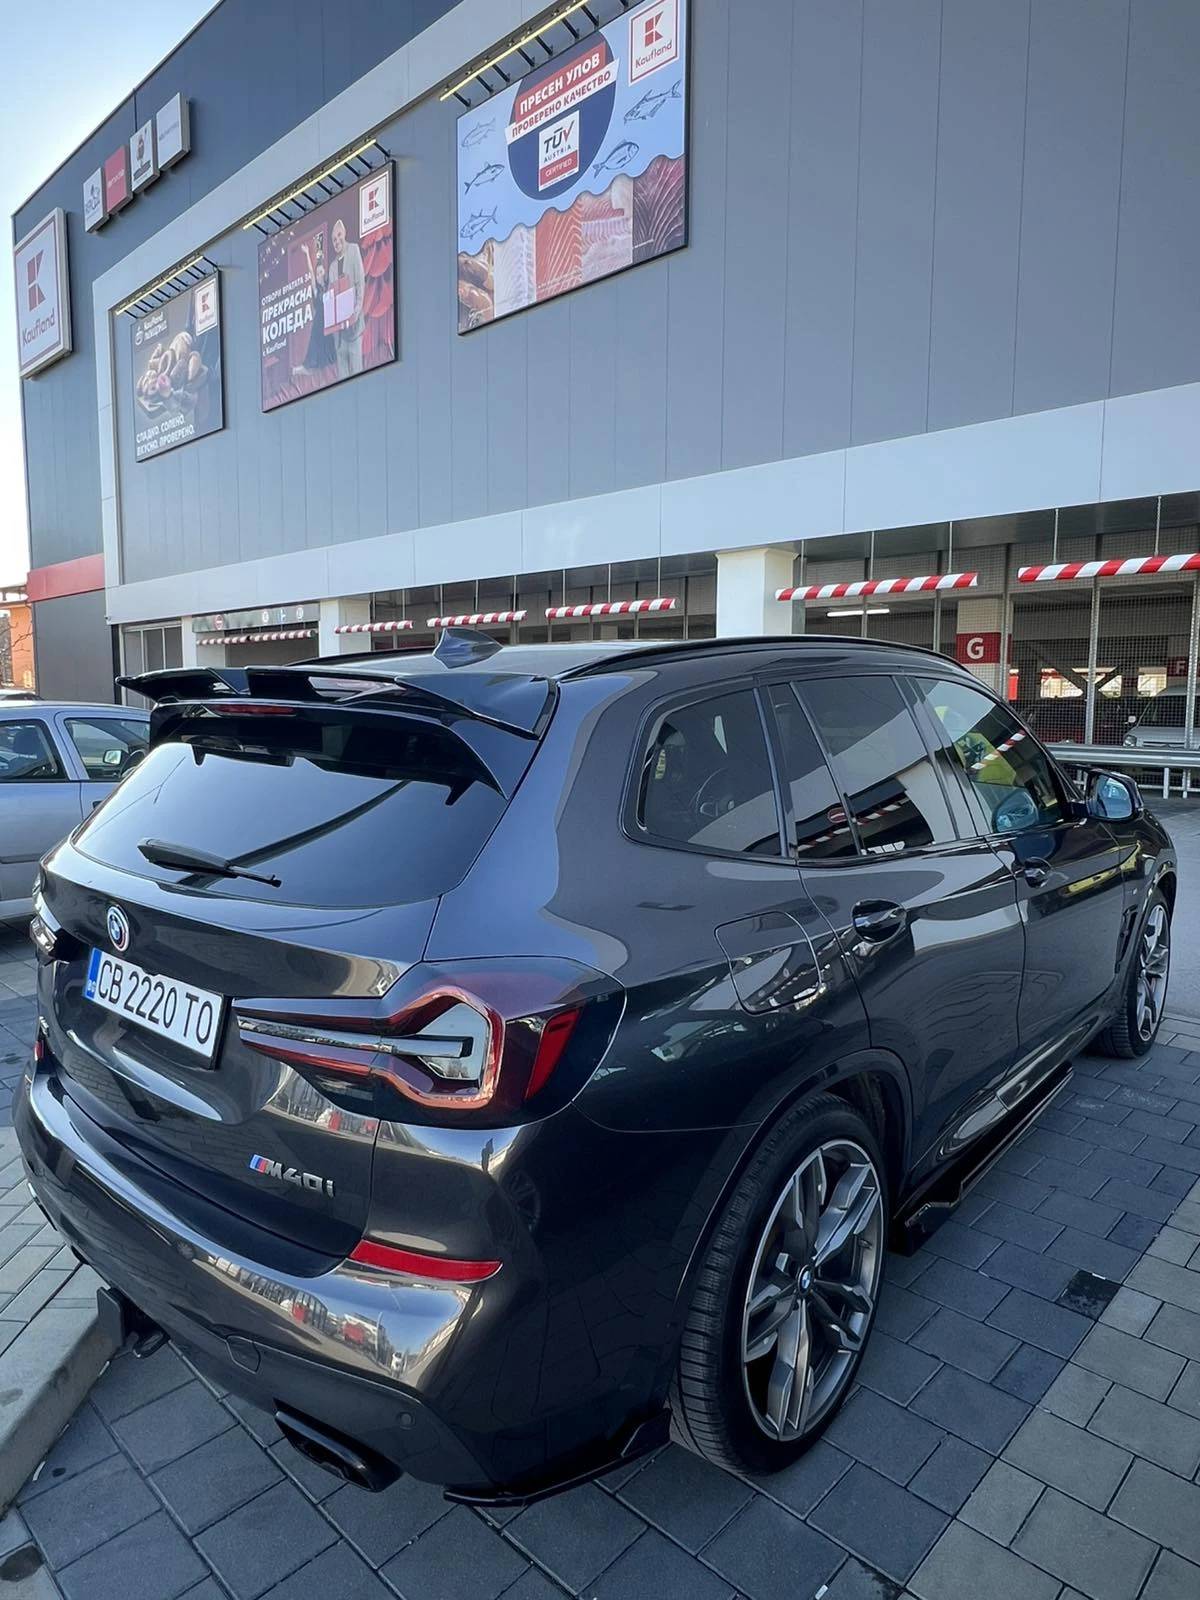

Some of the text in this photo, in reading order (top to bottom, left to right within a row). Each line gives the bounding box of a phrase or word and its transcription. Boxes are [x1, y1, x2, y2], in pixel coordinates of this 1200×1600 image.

[635, 40, 673, 69] Kaufland
[520, 53, 600, 115] ПРЕСЕН УЛОВ
[512, 70, 611, 138] ПРОВЕРЕНО КАЧЕСТВО
[544, 144, 572, 163] AUSTRIA
[545, 158, 573, 177] CERTIFIED
[261, 288, 282, 306] ОТВОРИ
[262, 285, 313, 324] ПРЕКРАСНА
[22, 307, 55, 347] Kaufland
[262, 303, 313, 345] КОЛЕДА
[966, 637, 985, 660] G
[98, 960, 213, 1045] CB 2220 TO
[265, 1160, 335, 1198] M40i
